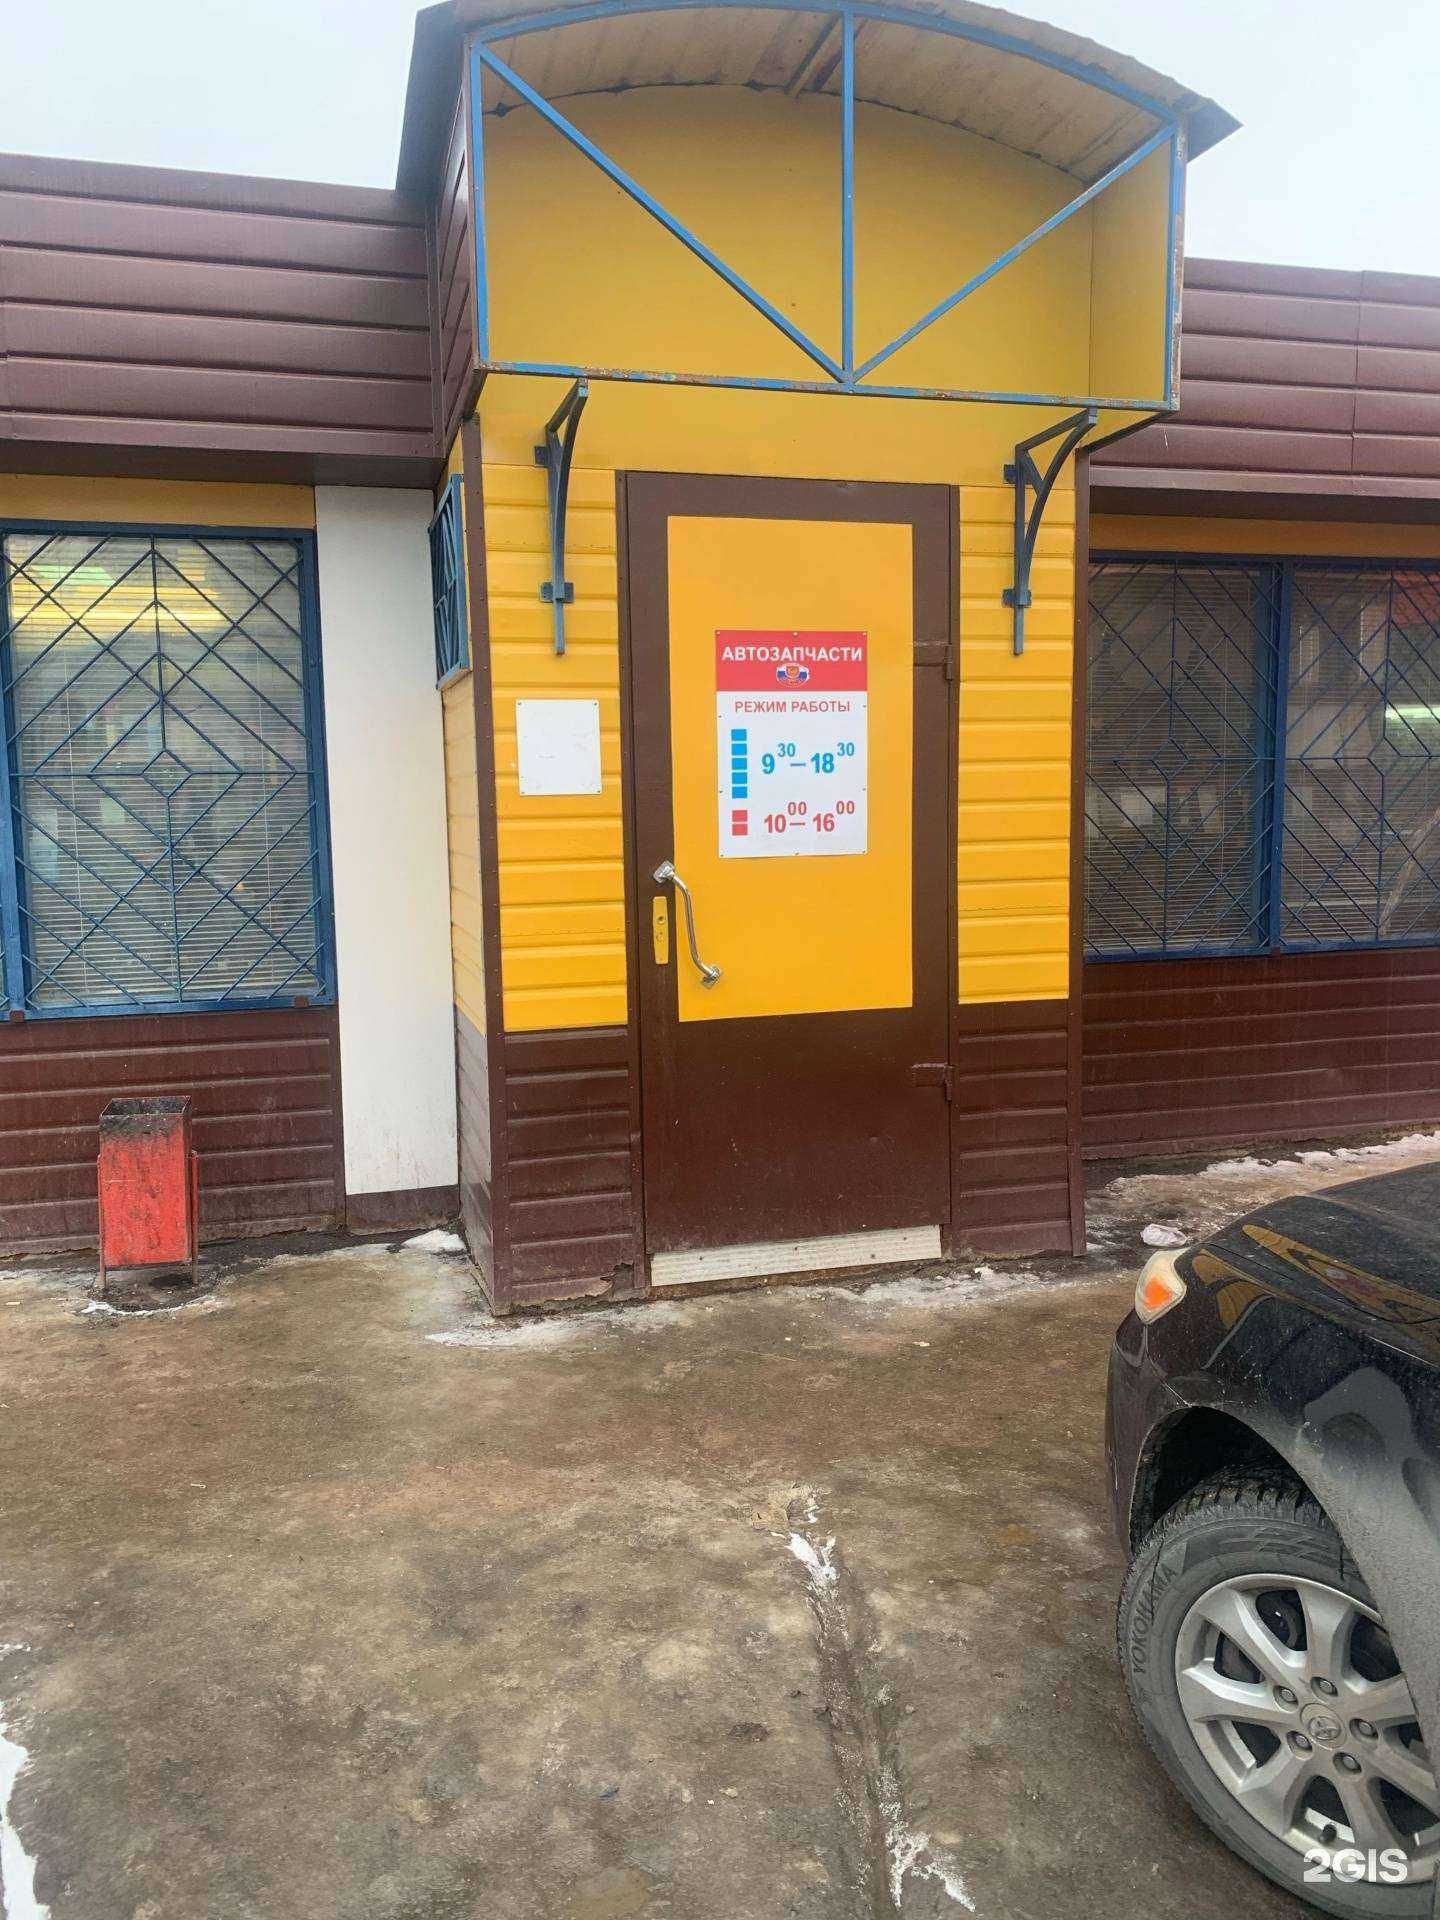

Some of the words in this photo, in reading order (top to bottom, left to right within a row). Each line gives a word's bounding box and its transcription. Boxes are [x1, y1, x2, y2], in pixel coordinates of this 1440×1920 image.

[721, 646, 863, 662] АВТОЗАПЧАСТИ
[734, 701, 787, 713] РЕЖИМ
[791, 701, 851, 713] РАБОТЫ
[1131, 1562, 1177, 1674] YOKOHAMA
